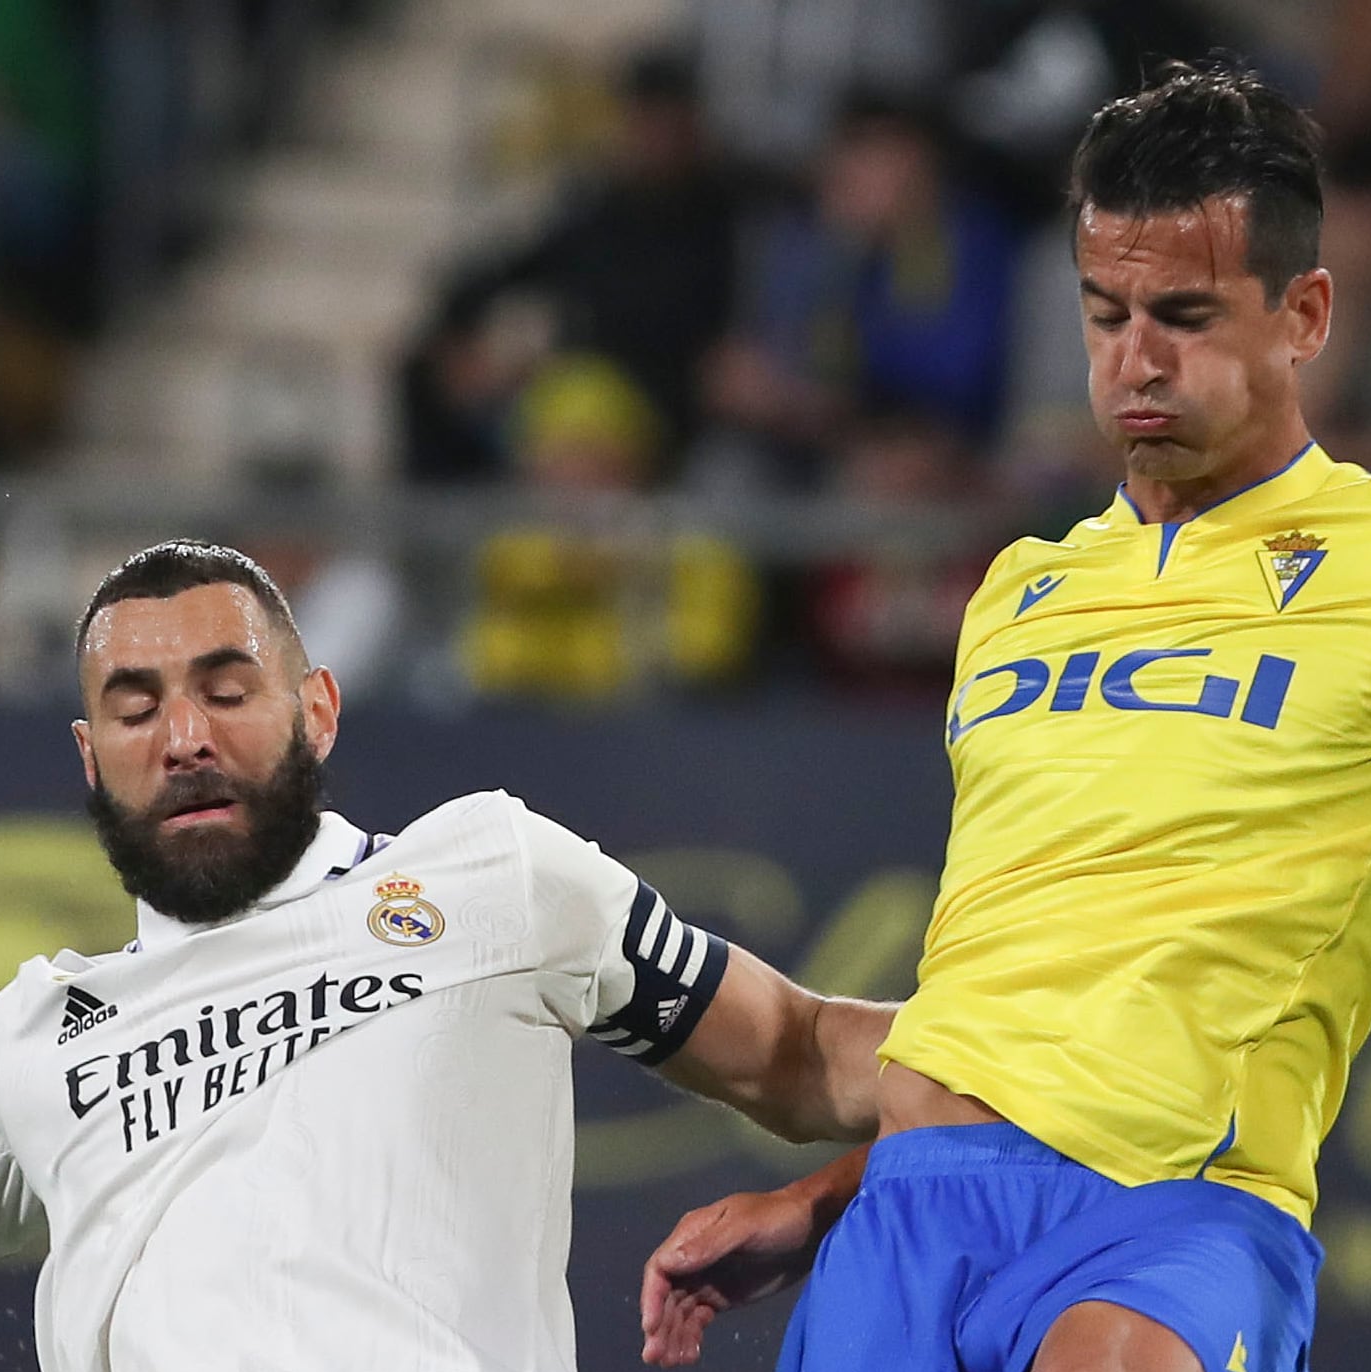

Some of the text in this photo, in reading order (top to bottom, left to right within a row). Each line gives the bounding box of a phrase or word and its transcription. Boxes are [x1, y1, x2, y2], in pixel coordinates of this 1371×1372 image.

[948, 647, 1296, 744] DIGI
[58, 1004, 119, 1046] adidas
[65, 971, 424, 1119] Emirates
[119, 1026, 354, 1153] FLY BETT
